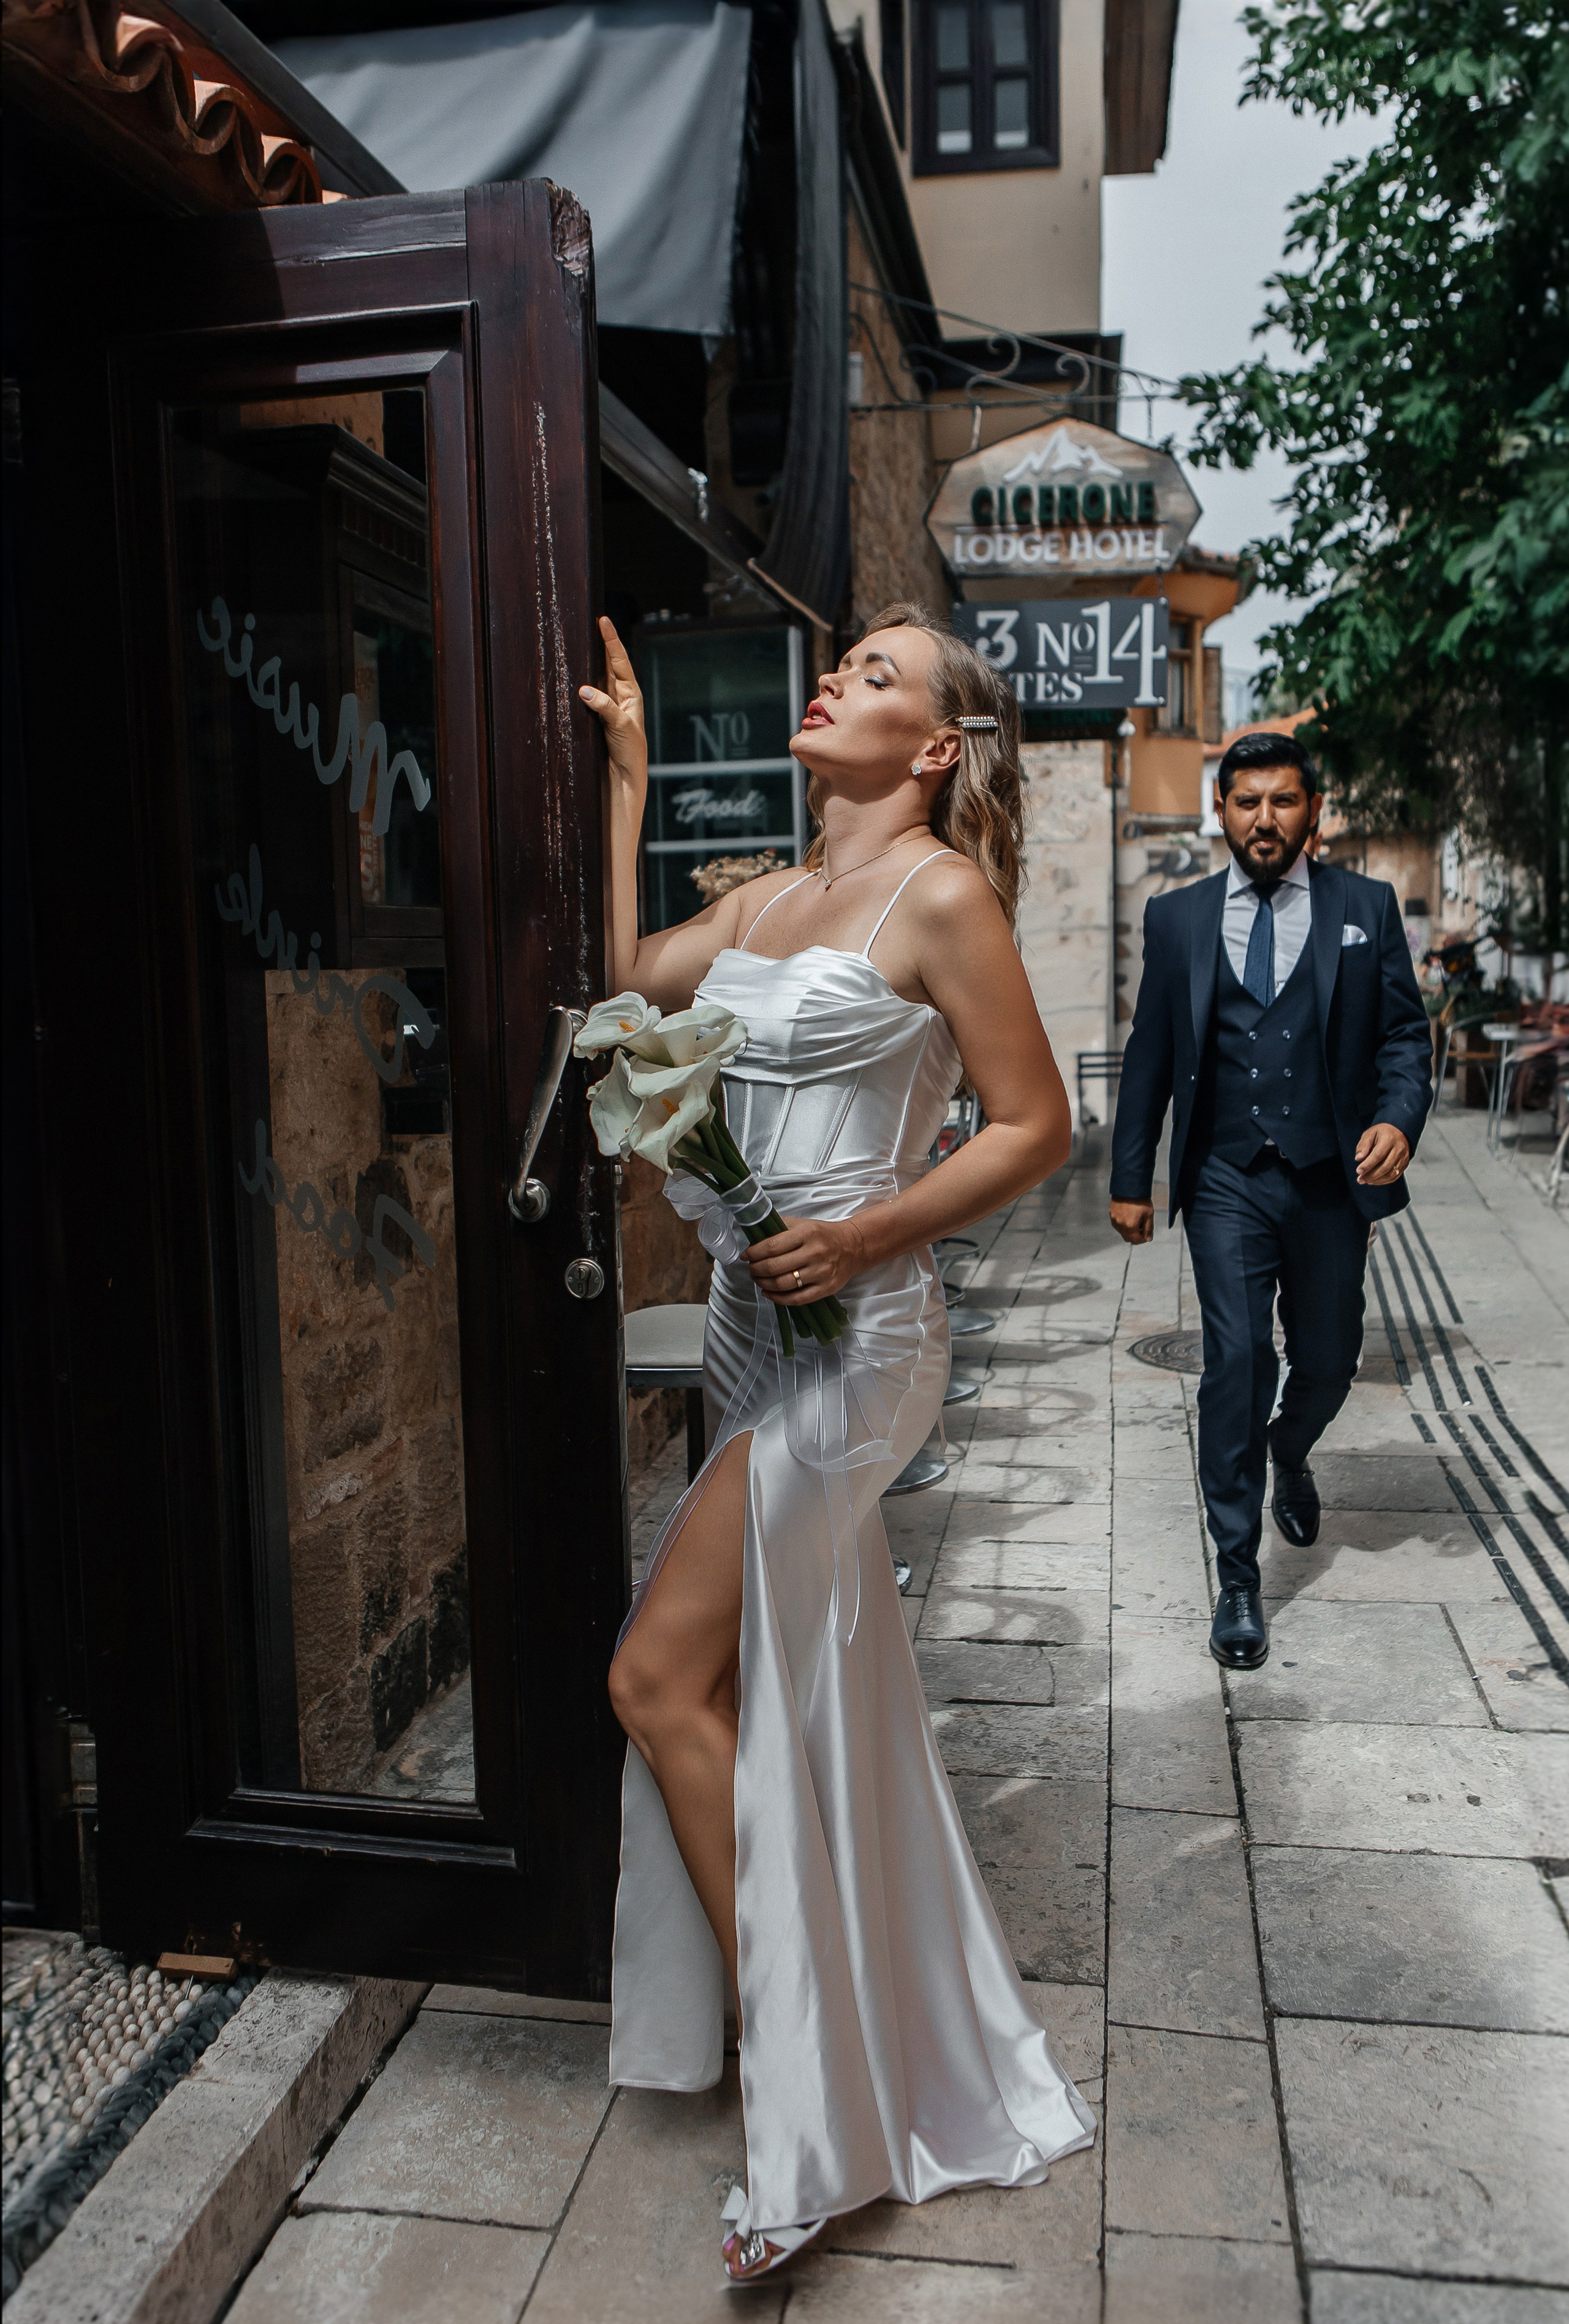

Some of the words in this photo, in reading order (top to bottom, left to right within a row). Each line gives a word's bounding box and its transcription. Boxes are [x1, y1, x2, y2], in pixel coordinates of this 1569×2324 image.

[971, 481, 1156, 526] CICERONE
[954, 531, 1060, 566] LODGE
[1069, 528, 1171, 561] HOTEL
[1010, 672, 1083, 704] TES
